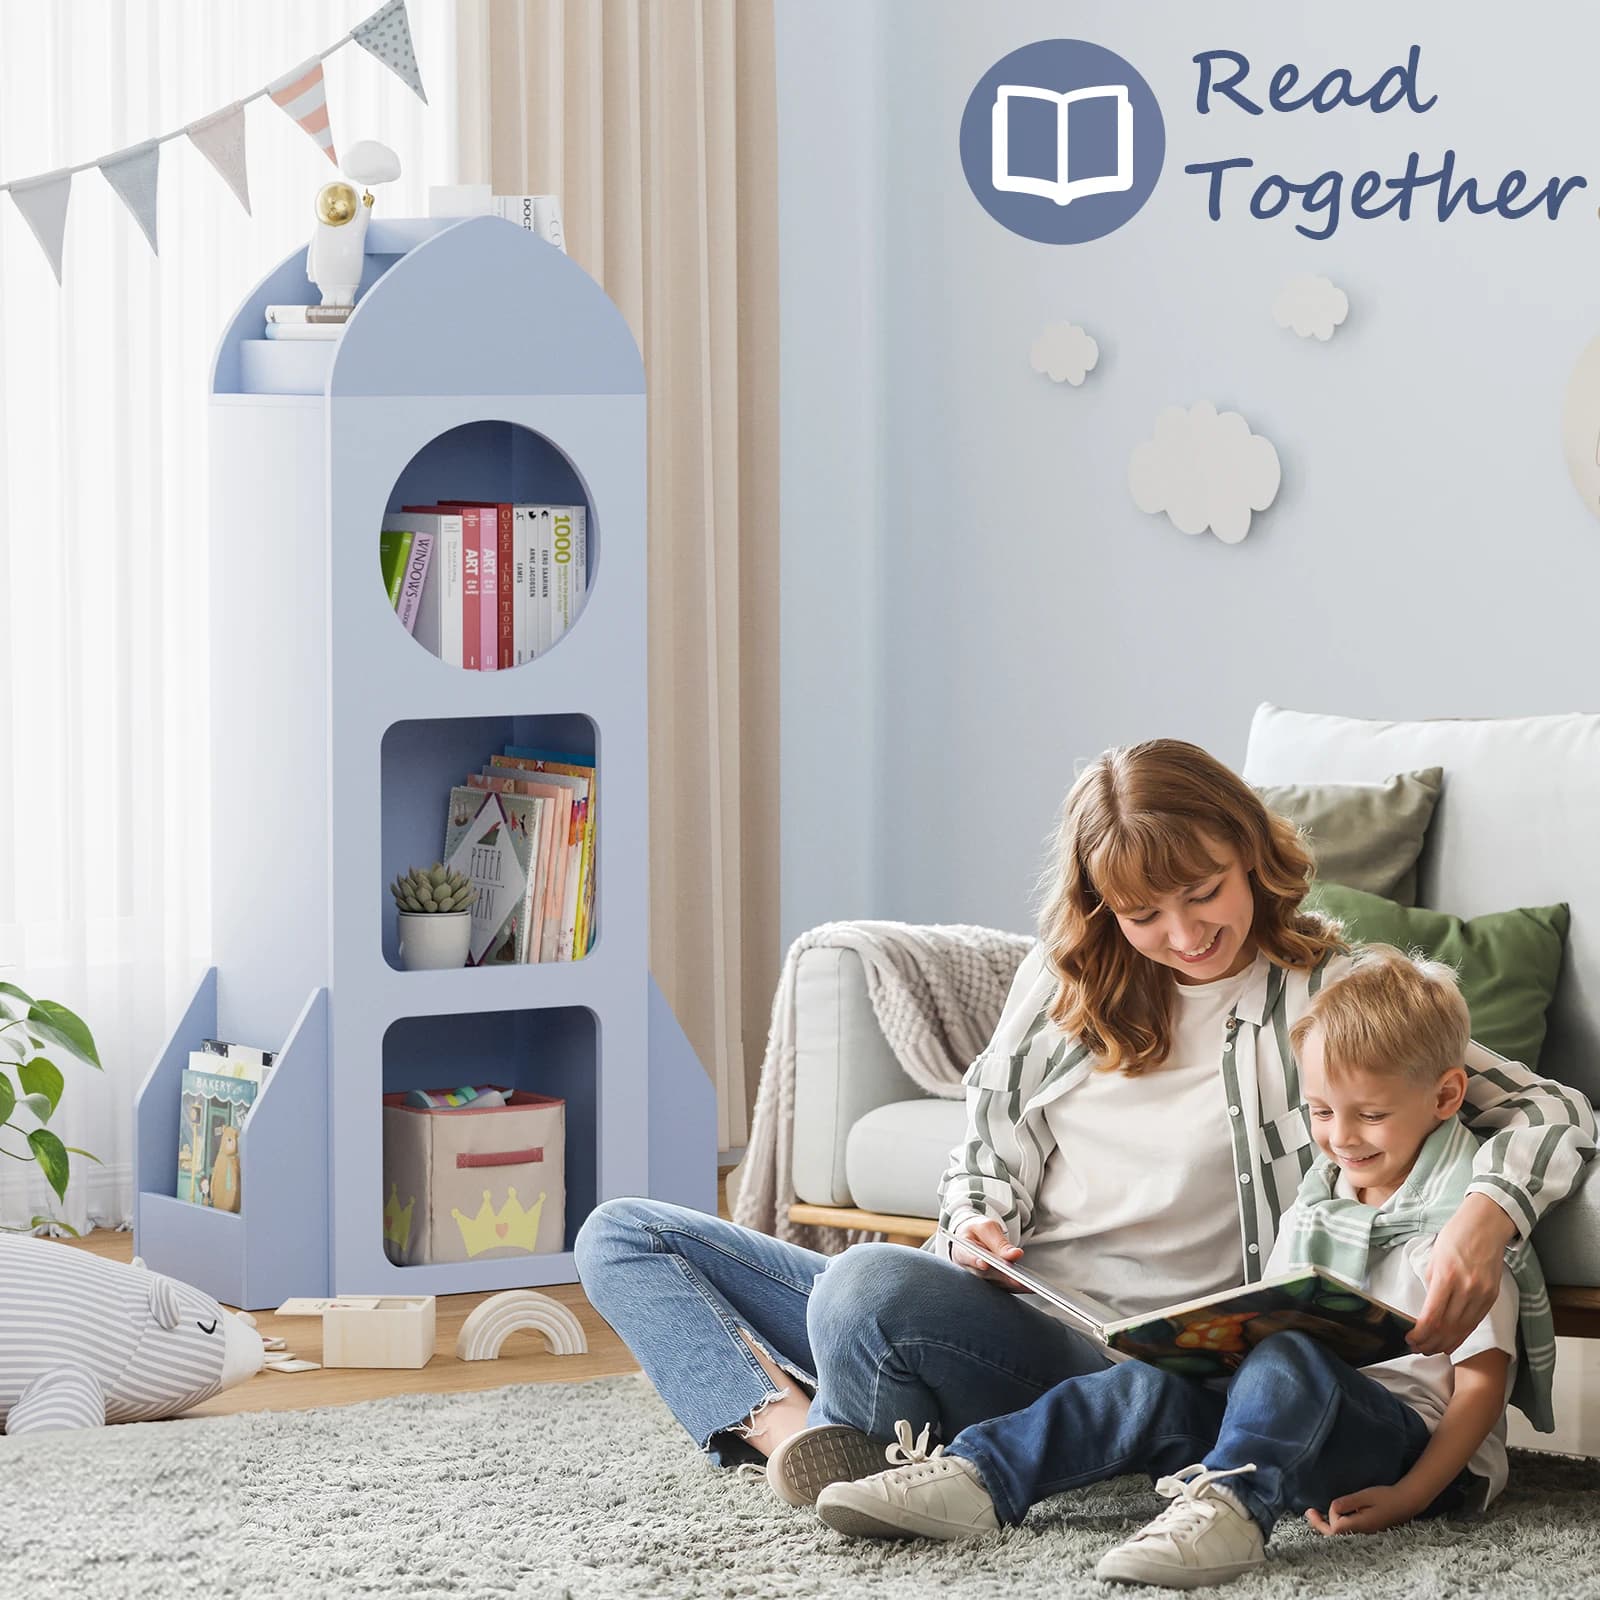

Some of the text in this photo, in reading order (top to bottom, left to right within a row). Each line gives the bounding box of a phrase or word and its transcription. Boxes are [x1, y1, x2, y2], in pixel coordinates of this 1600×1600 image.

[554, 514, 571, 564] 1000
[405, 538, 431, 599] WINDOWS
[465, 548, 478, 575] ART
[483, 548, 496, 575] ART
[501, 509, 512, 636] Over the Top
[469, 847, 503, 882] PETER
[195, 1077, 232, 1094] BAKERY
